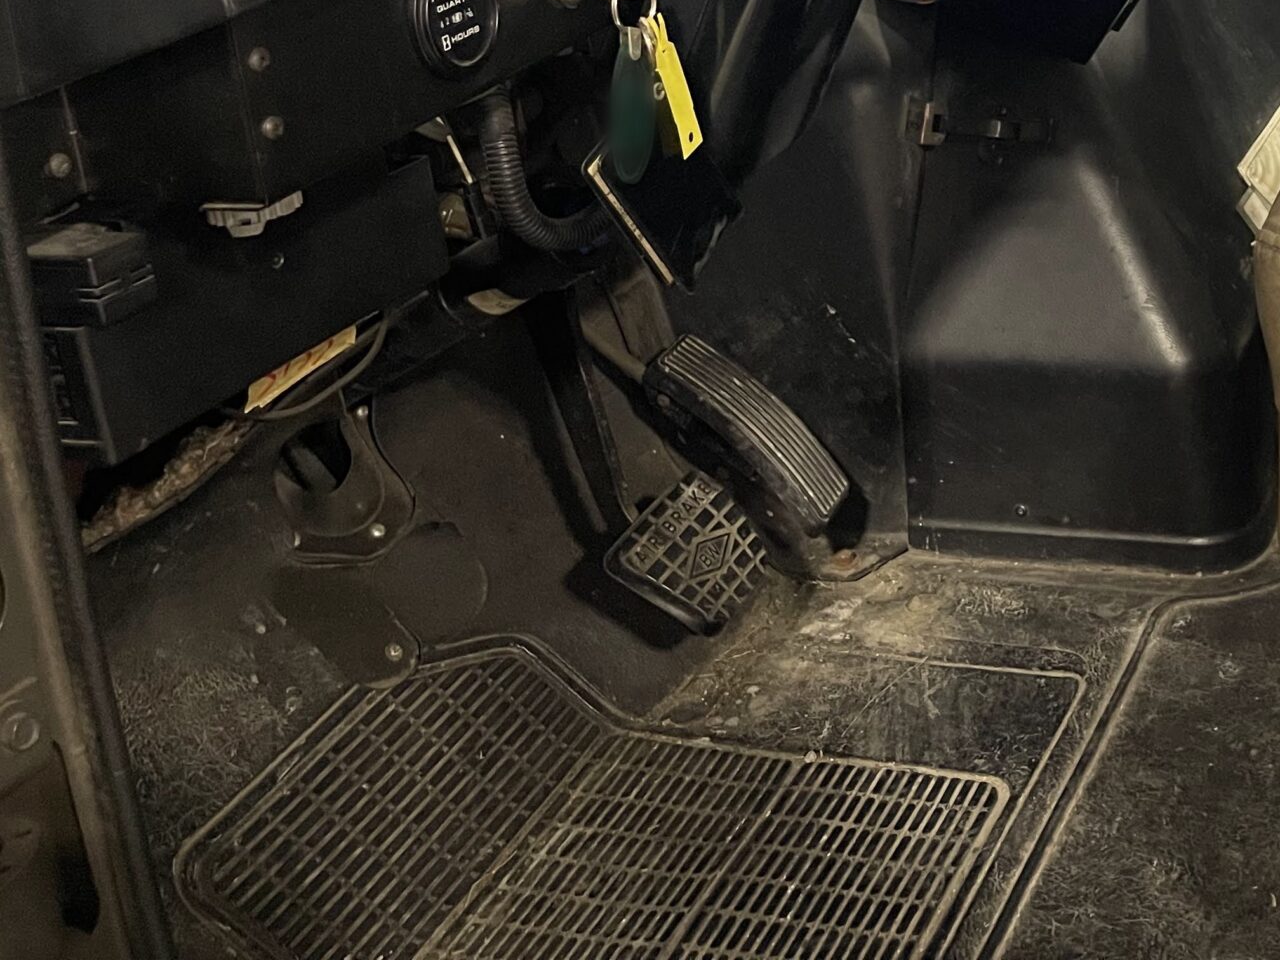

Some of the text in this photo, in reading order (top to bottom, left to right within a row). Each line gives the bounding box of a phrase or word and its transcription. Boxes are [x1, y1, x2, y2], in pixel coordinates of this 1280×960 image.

[451, 25, 480, 43] HOURS
[635, 481, 713, 564] AIR BRAKE
[700, 543, 720, 567] BW
